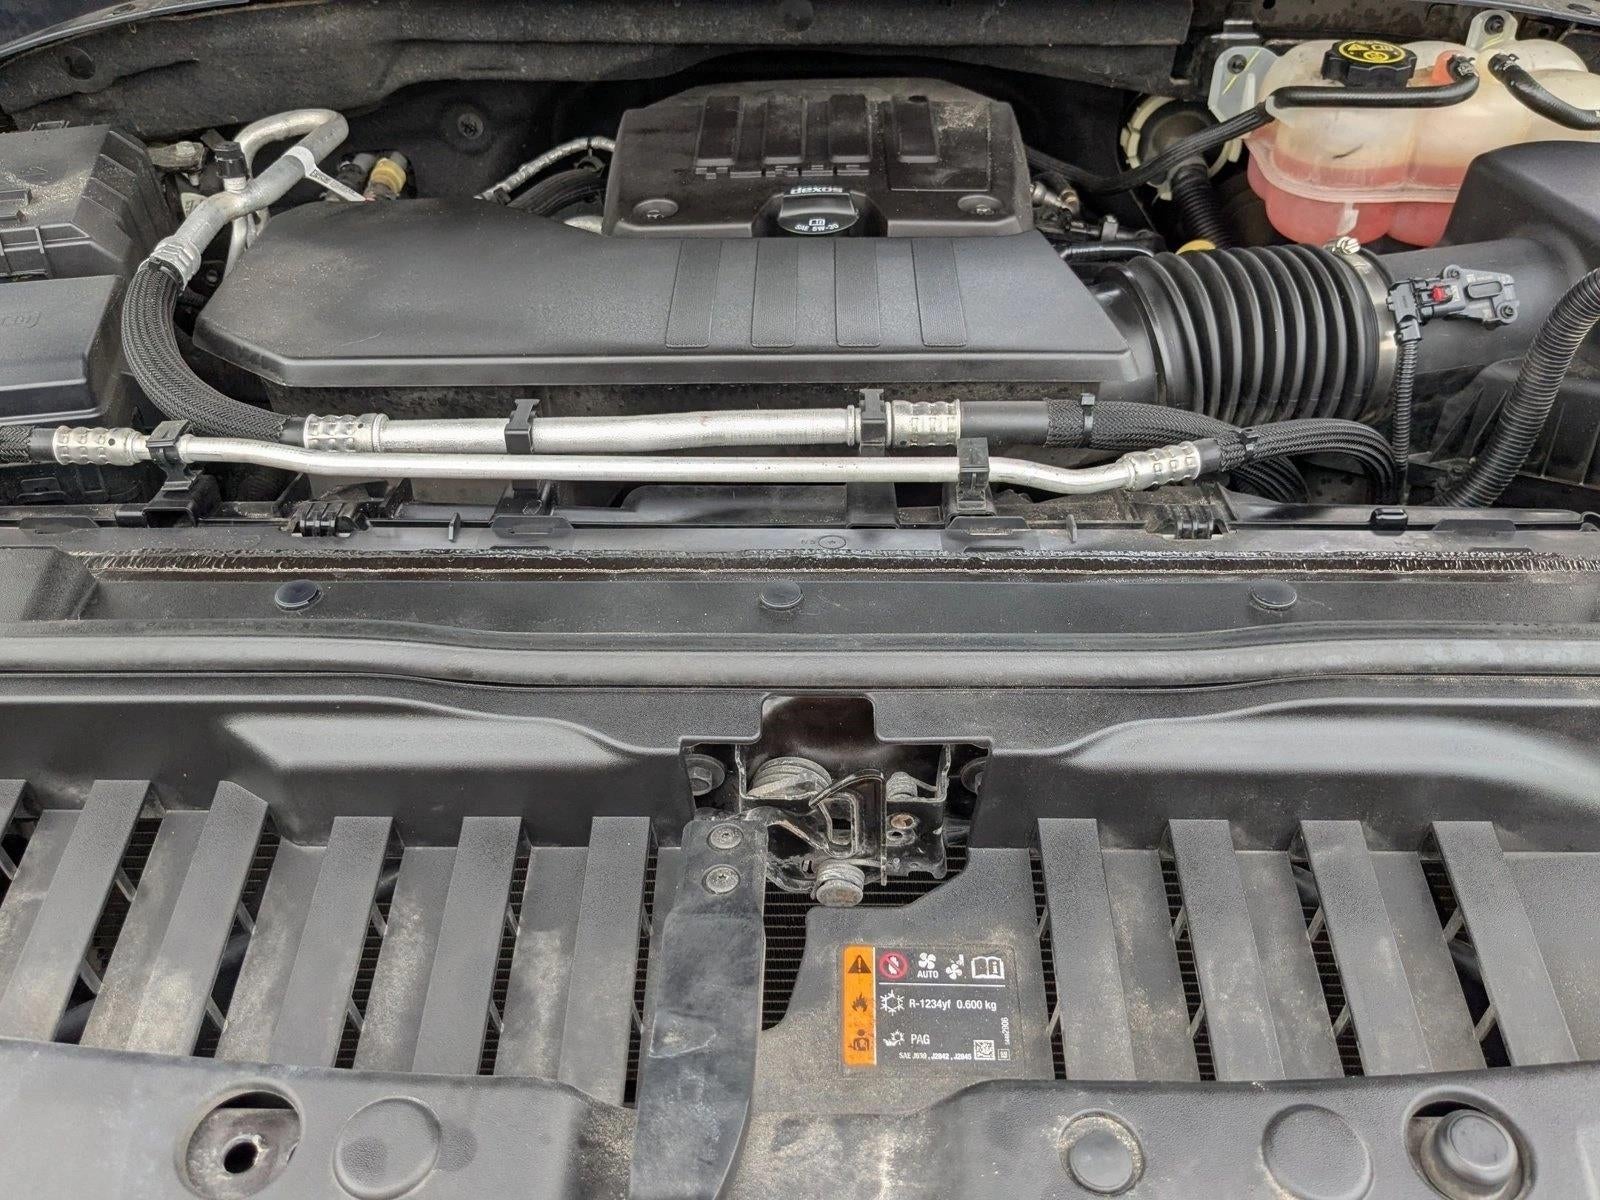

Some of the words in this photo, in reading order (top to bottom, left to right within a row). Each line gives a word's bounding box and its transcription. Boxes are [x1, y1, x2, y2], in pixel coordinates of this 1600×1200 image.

[790, 186, 843, 195] dexos
[794, 224, 810, 232] SAE
[917, 970, 939, 979] AUTO
[909, 998, 951, 1011] R-1234yf
[956, 998, 983, 1010] 0.600
[985, 999, 997, 1012] kg
[910, 1033, 931, 1045] PAG
